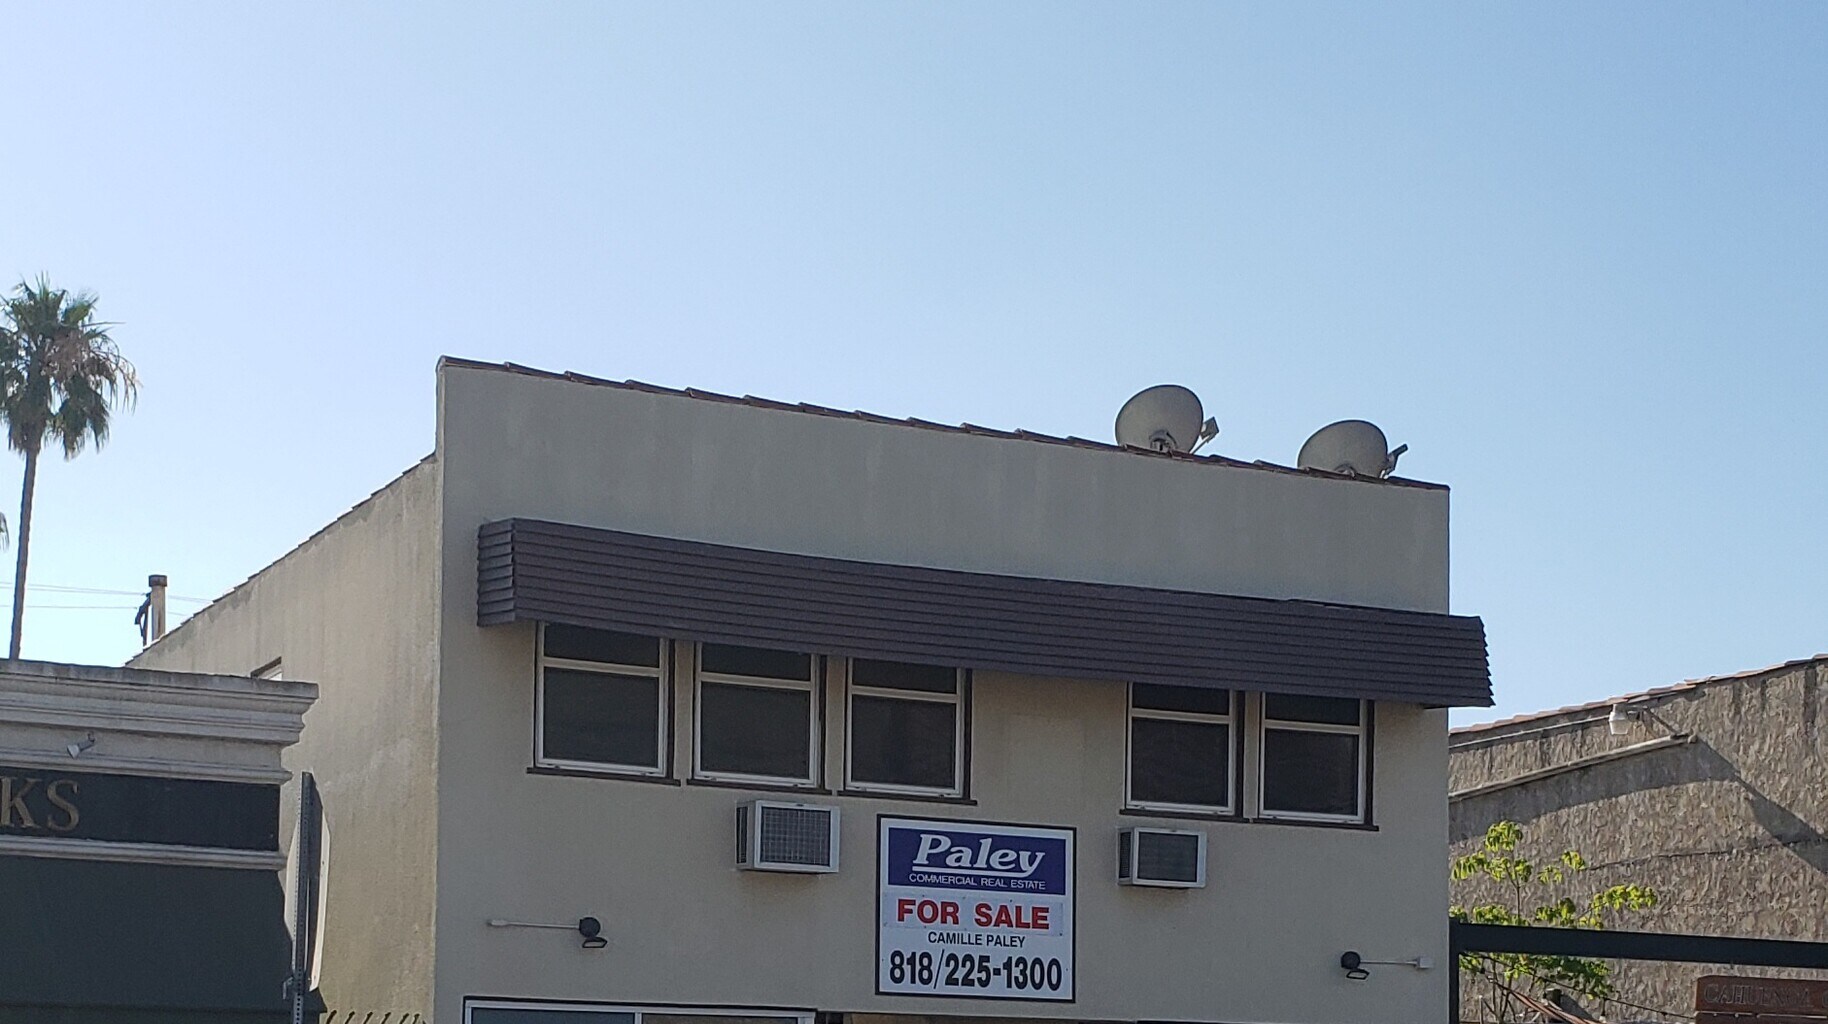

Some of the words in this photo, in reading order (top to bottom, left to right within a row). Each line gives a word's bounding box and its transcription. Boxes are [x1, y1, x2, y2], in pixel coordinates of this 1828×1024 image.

[0, 775, 79, 832] KS
[912, 833, 1046, 878] Paley
[908, 873, 978, 887] COMMERCIAL
[980, 877, 1008, 888] REAL
[1010, 879, 1046, 890] ESTATE
[897, 898, 960, 925] FOR
[974, 902, 1050, 930] SALE
[927, 931, 983, 946] CAMILLE
[986, 934, 1026, 948] PALEY
[889, 949, 1062, 992] 818/225-1300
